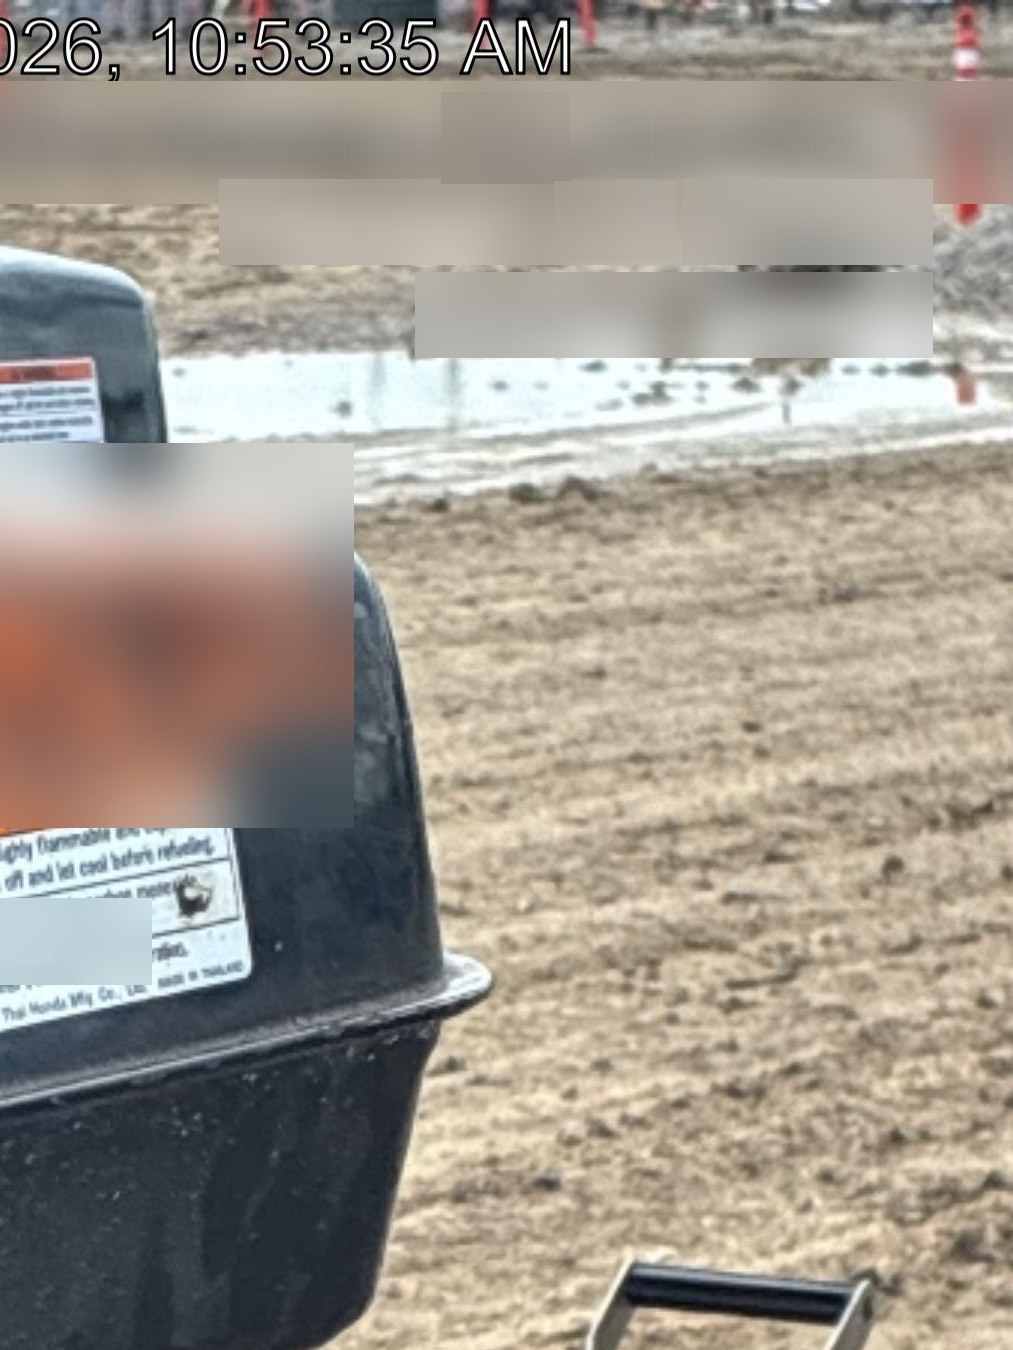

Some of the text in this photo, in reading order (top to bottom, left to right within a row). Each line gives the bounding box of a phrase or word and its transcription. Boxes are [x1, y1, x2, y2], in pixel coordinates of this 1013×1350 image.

[5, 869, 23, 891] off
[29, 863, 53, 886] and
[57, 861, 75, 880] let
[80, 852, 108, 877] cool
[110, 845, 154, 870] before
